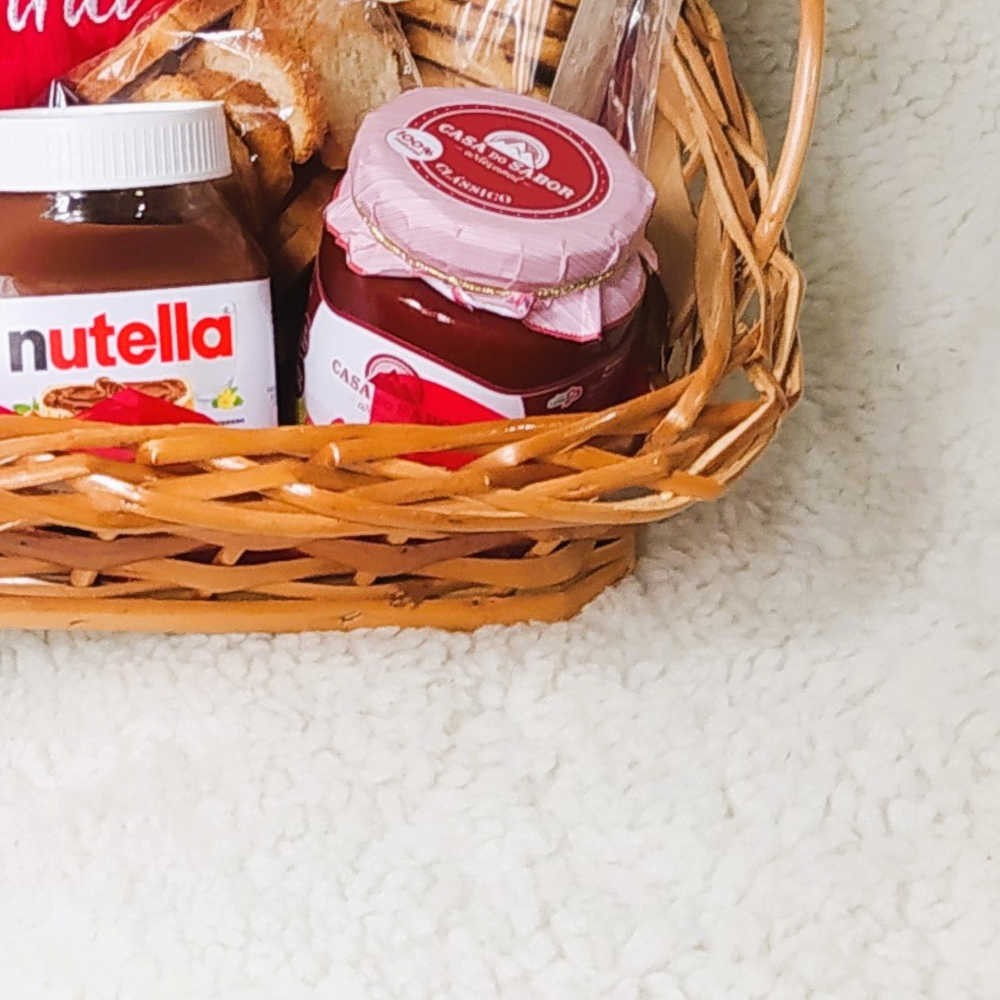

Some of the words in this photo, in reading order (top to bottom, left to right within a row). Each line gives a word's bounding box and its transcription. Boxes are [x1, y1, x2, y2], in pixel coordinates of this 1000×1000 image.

[437, 122, 488, 155] CASA
[487, 151, 509, 167] DO
[507, 160, 576, 201] SABOR
[7, 301, 234, 373] nutella
[331, 358, 370, 400] CASA
